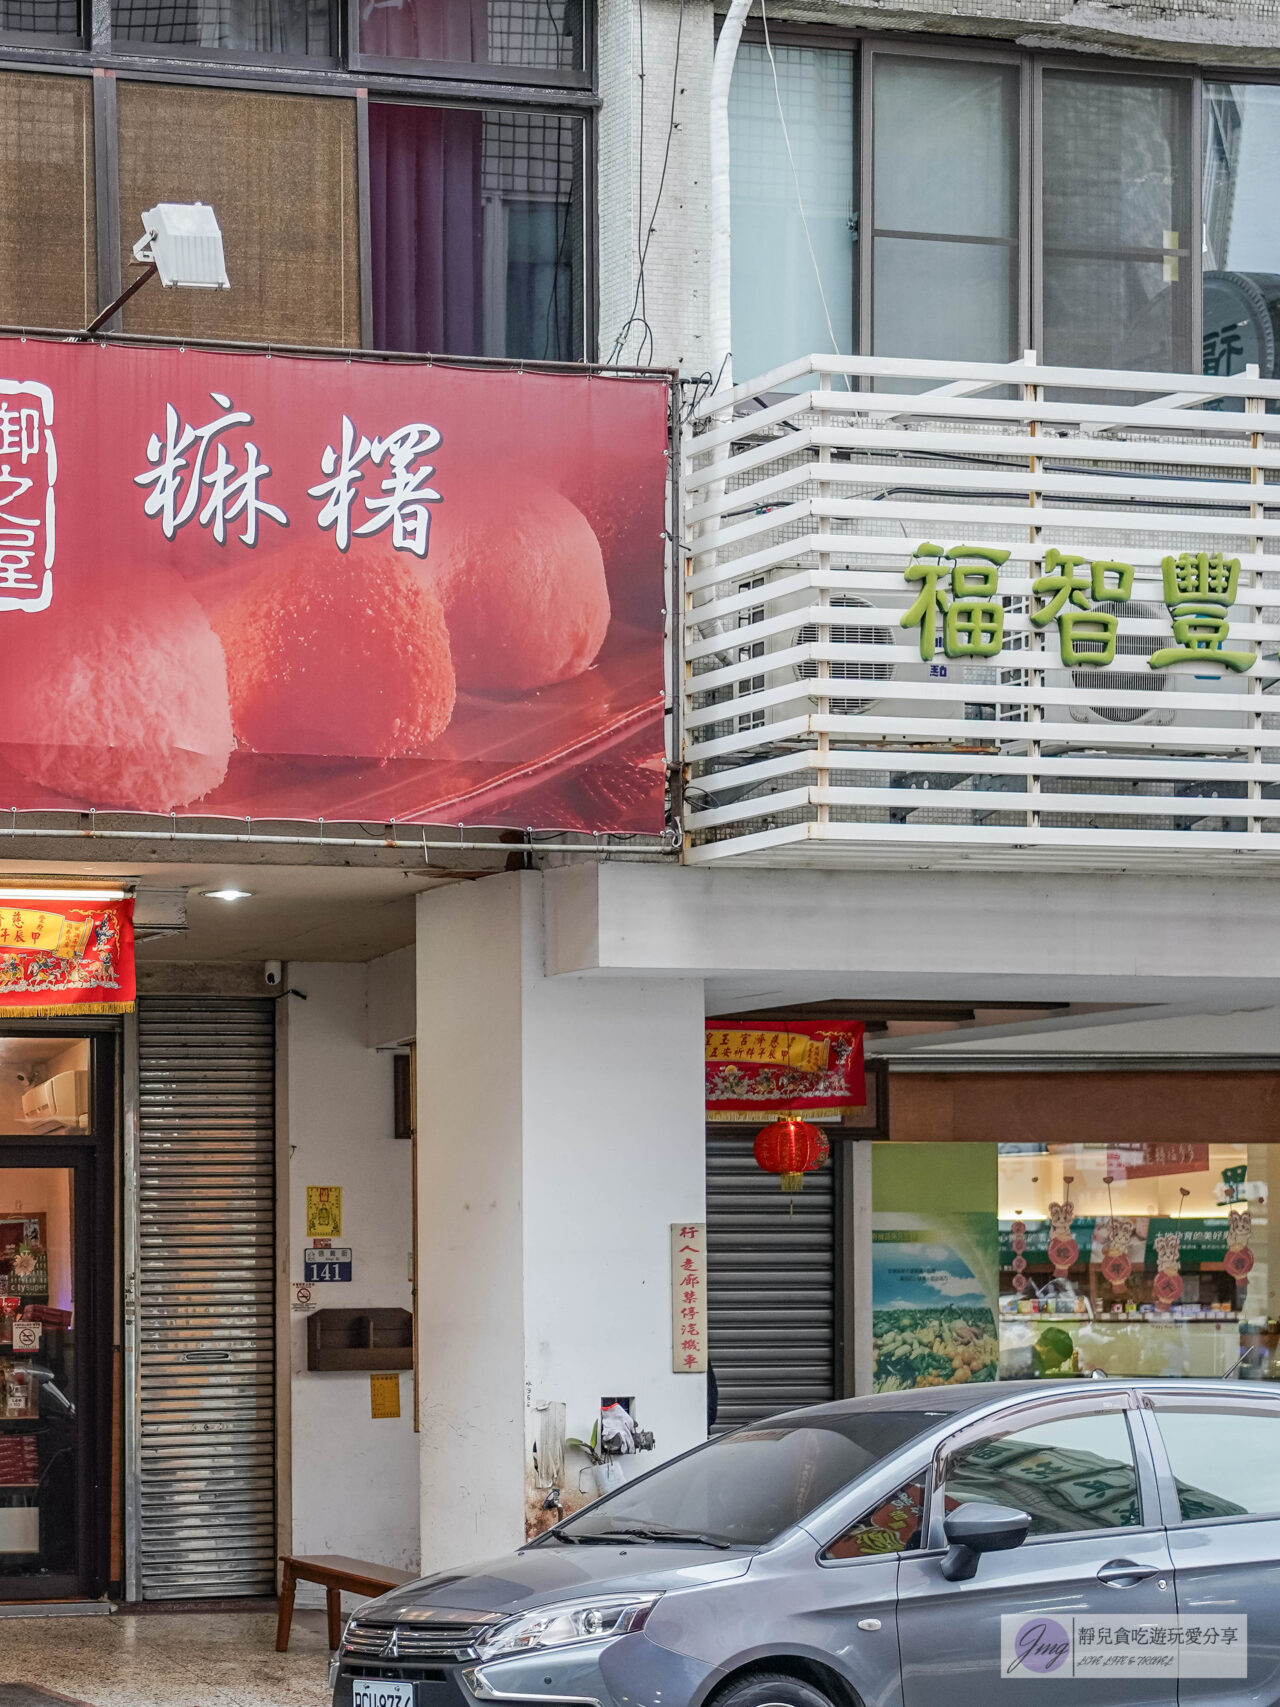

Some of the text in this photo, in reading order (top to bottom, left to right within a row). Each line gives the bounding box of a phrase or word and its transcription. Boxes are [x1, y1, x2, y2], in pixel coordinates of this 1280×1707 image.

[900, 541, 1280, 674] 福智豐
[310, 1263, 342, 1281] 141
[679, 1226, 701, 1369] 行人走廊禁停汽機車
